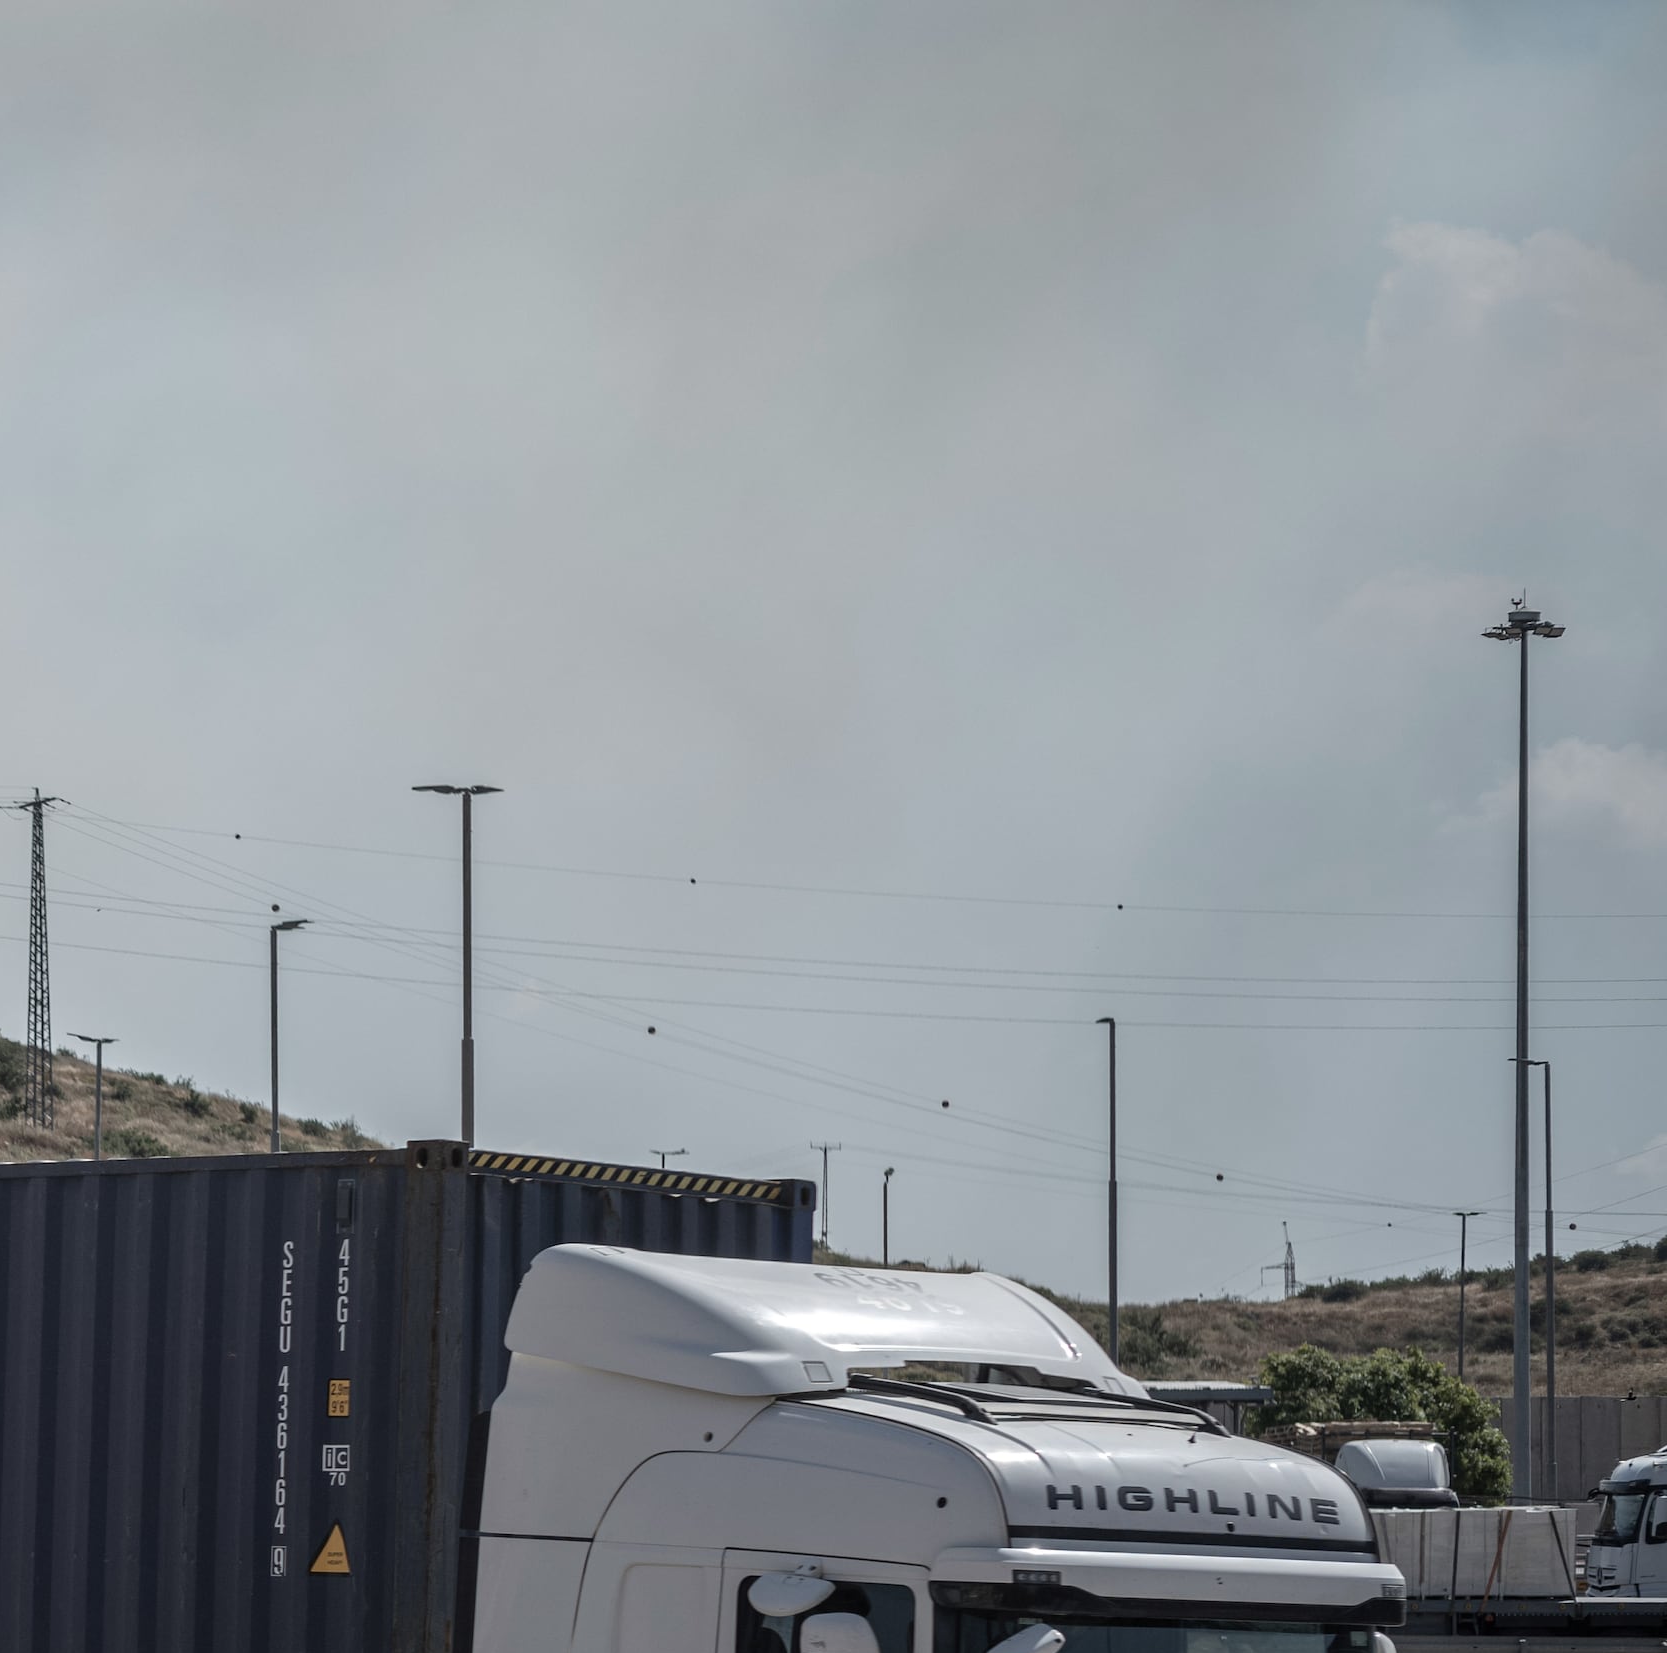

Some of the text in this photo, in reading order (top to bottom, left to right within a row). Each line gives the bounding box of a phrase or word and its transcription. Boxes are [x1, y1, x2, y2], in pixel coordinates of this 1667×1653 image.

[278, 1240, 294, 1353] SEGU
[336, 1239, 350, 1352] 45G1
[273, 1365, 289, 1534] 436164
[329, 1472, 346, 1486] 70
[1046, 1483, 1341, 1527] HIGHLINE
